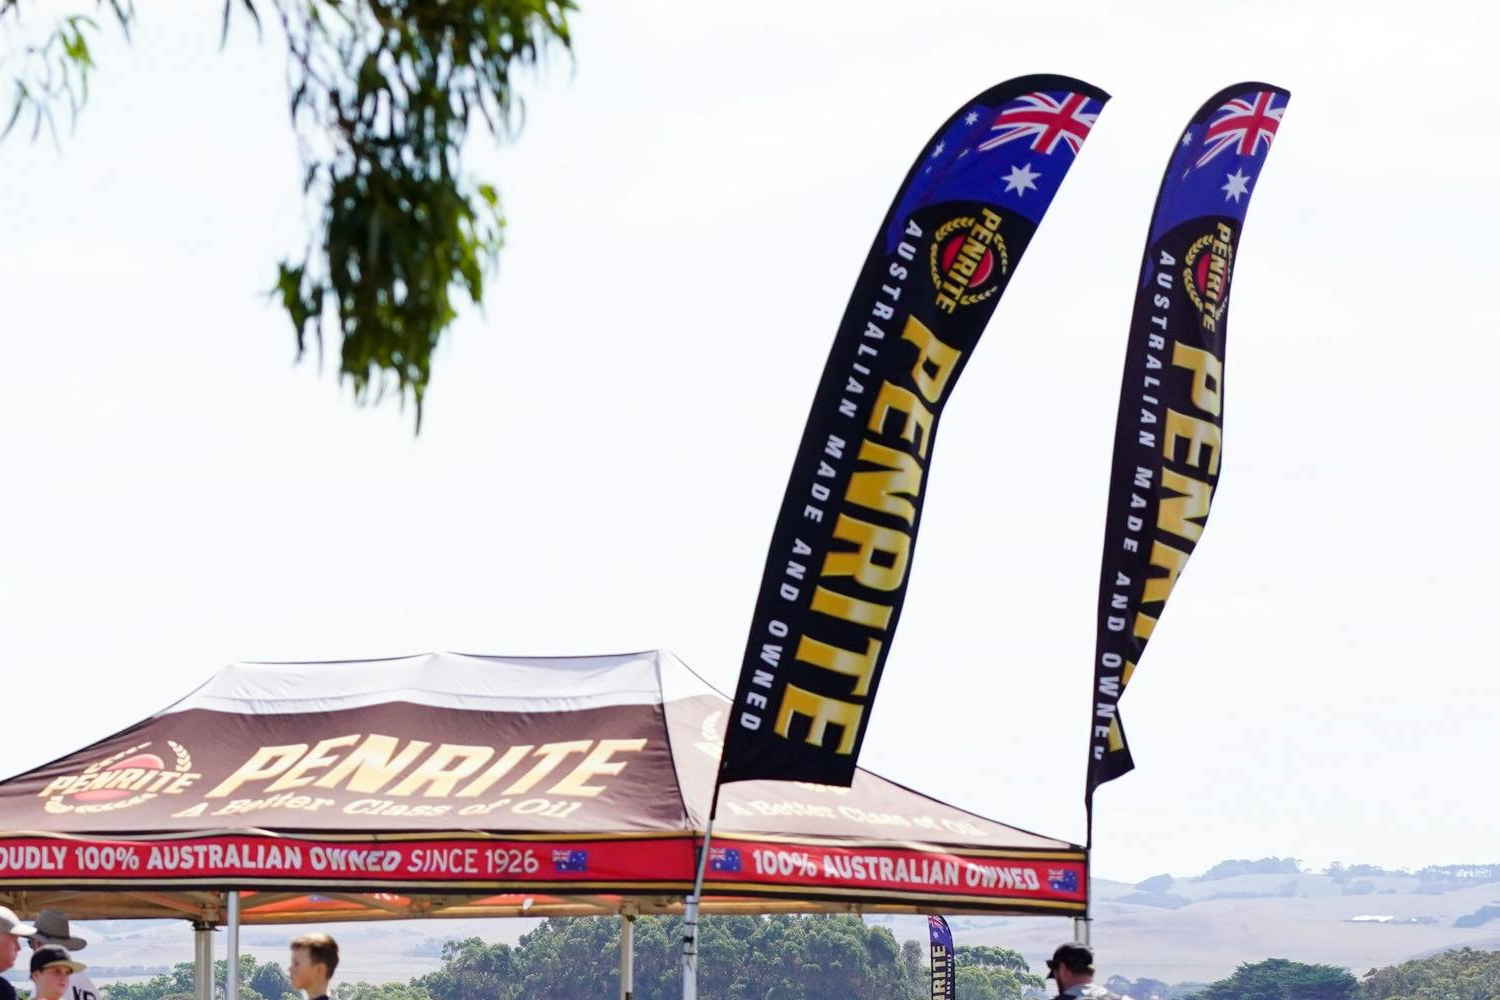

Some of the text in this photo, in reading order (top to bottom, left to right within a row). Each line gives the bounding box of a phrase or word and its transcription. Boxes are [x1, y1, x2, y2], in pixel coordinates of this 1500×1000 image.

[937, 207, 1002, 314] PENRITE
[1203, 222, 1232, 333] PENRITE
[1139, 250, 1176, 447] AUSTRALIAN
[740, 219, 923, 731] AUSTRALIAN MADE AND OWNED
[774, 314, 962, 755] PENRITE
[1123, 466, 1153, 553] MADE
[1107, 571, 1131, 632] AND
[38, 773, 201, 797] PENRITE
[205, 733, 647, 798] PENRITE
[172, 792, 582, 818] A Better Class of Oil
[840, 807, 910, 827] Class
[75, 847, 139, 870] 100%
[147, 844, 301, 871] AUSTRALIAN
[310, 847, 400, 872] OWNED
[407, 849, 478, 874] SINCE
[485, 850, 539, 874] 1926
[752, 849, 1040, 891] 100% AUSTRALIAN OWNED
